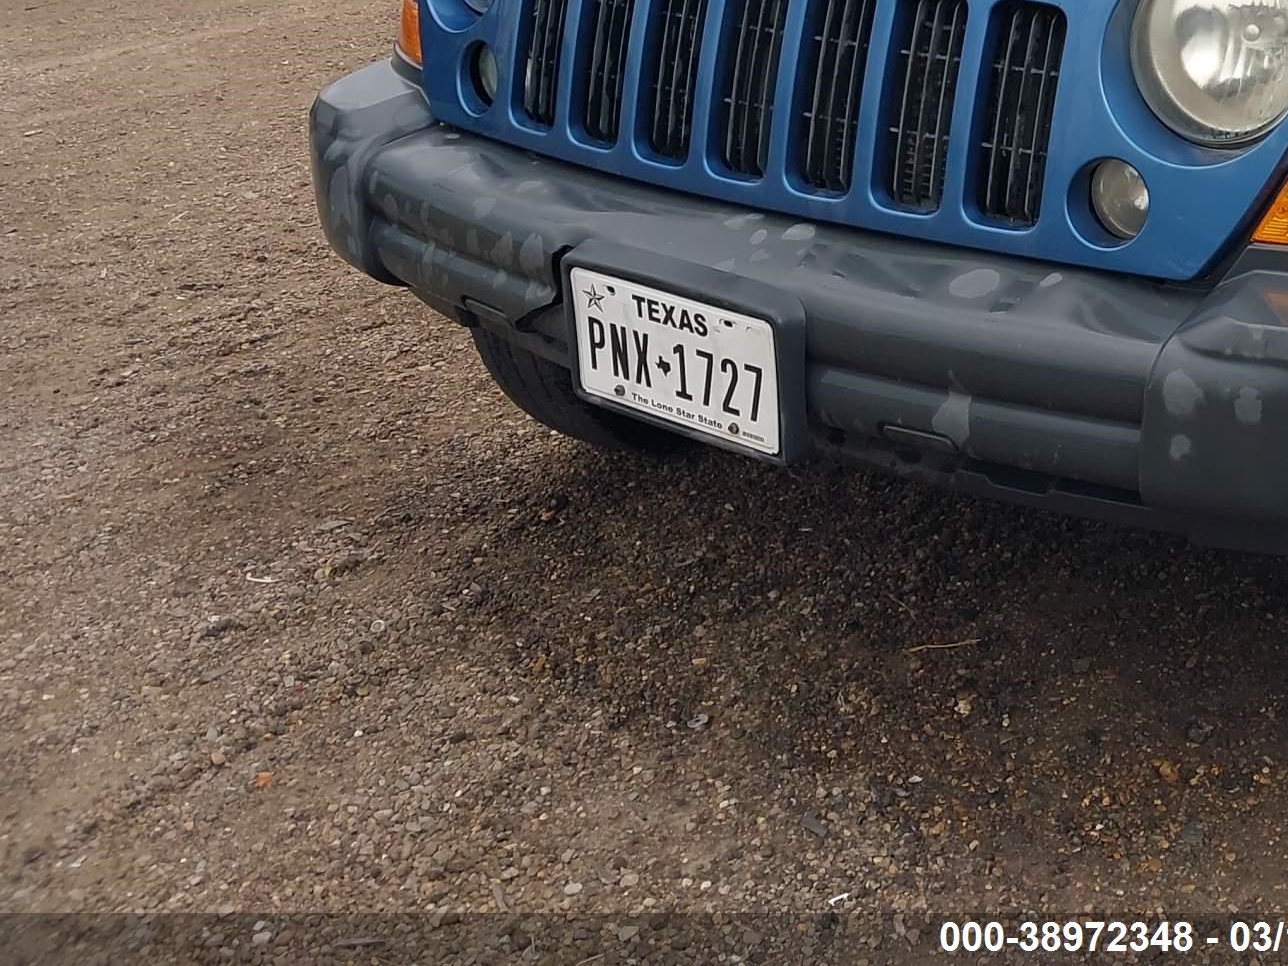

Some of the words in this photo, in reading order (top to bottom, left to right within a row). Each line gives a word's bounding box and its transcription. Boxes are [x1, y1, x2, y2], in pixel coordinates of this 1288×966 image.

[632, 294, 709, 337] TEXAS
[631, 392, 649, 405] The
[651, 399, 674, 413] Lone
[676, 407, 696, 420] Star
[697, 414, 723, 429] State
